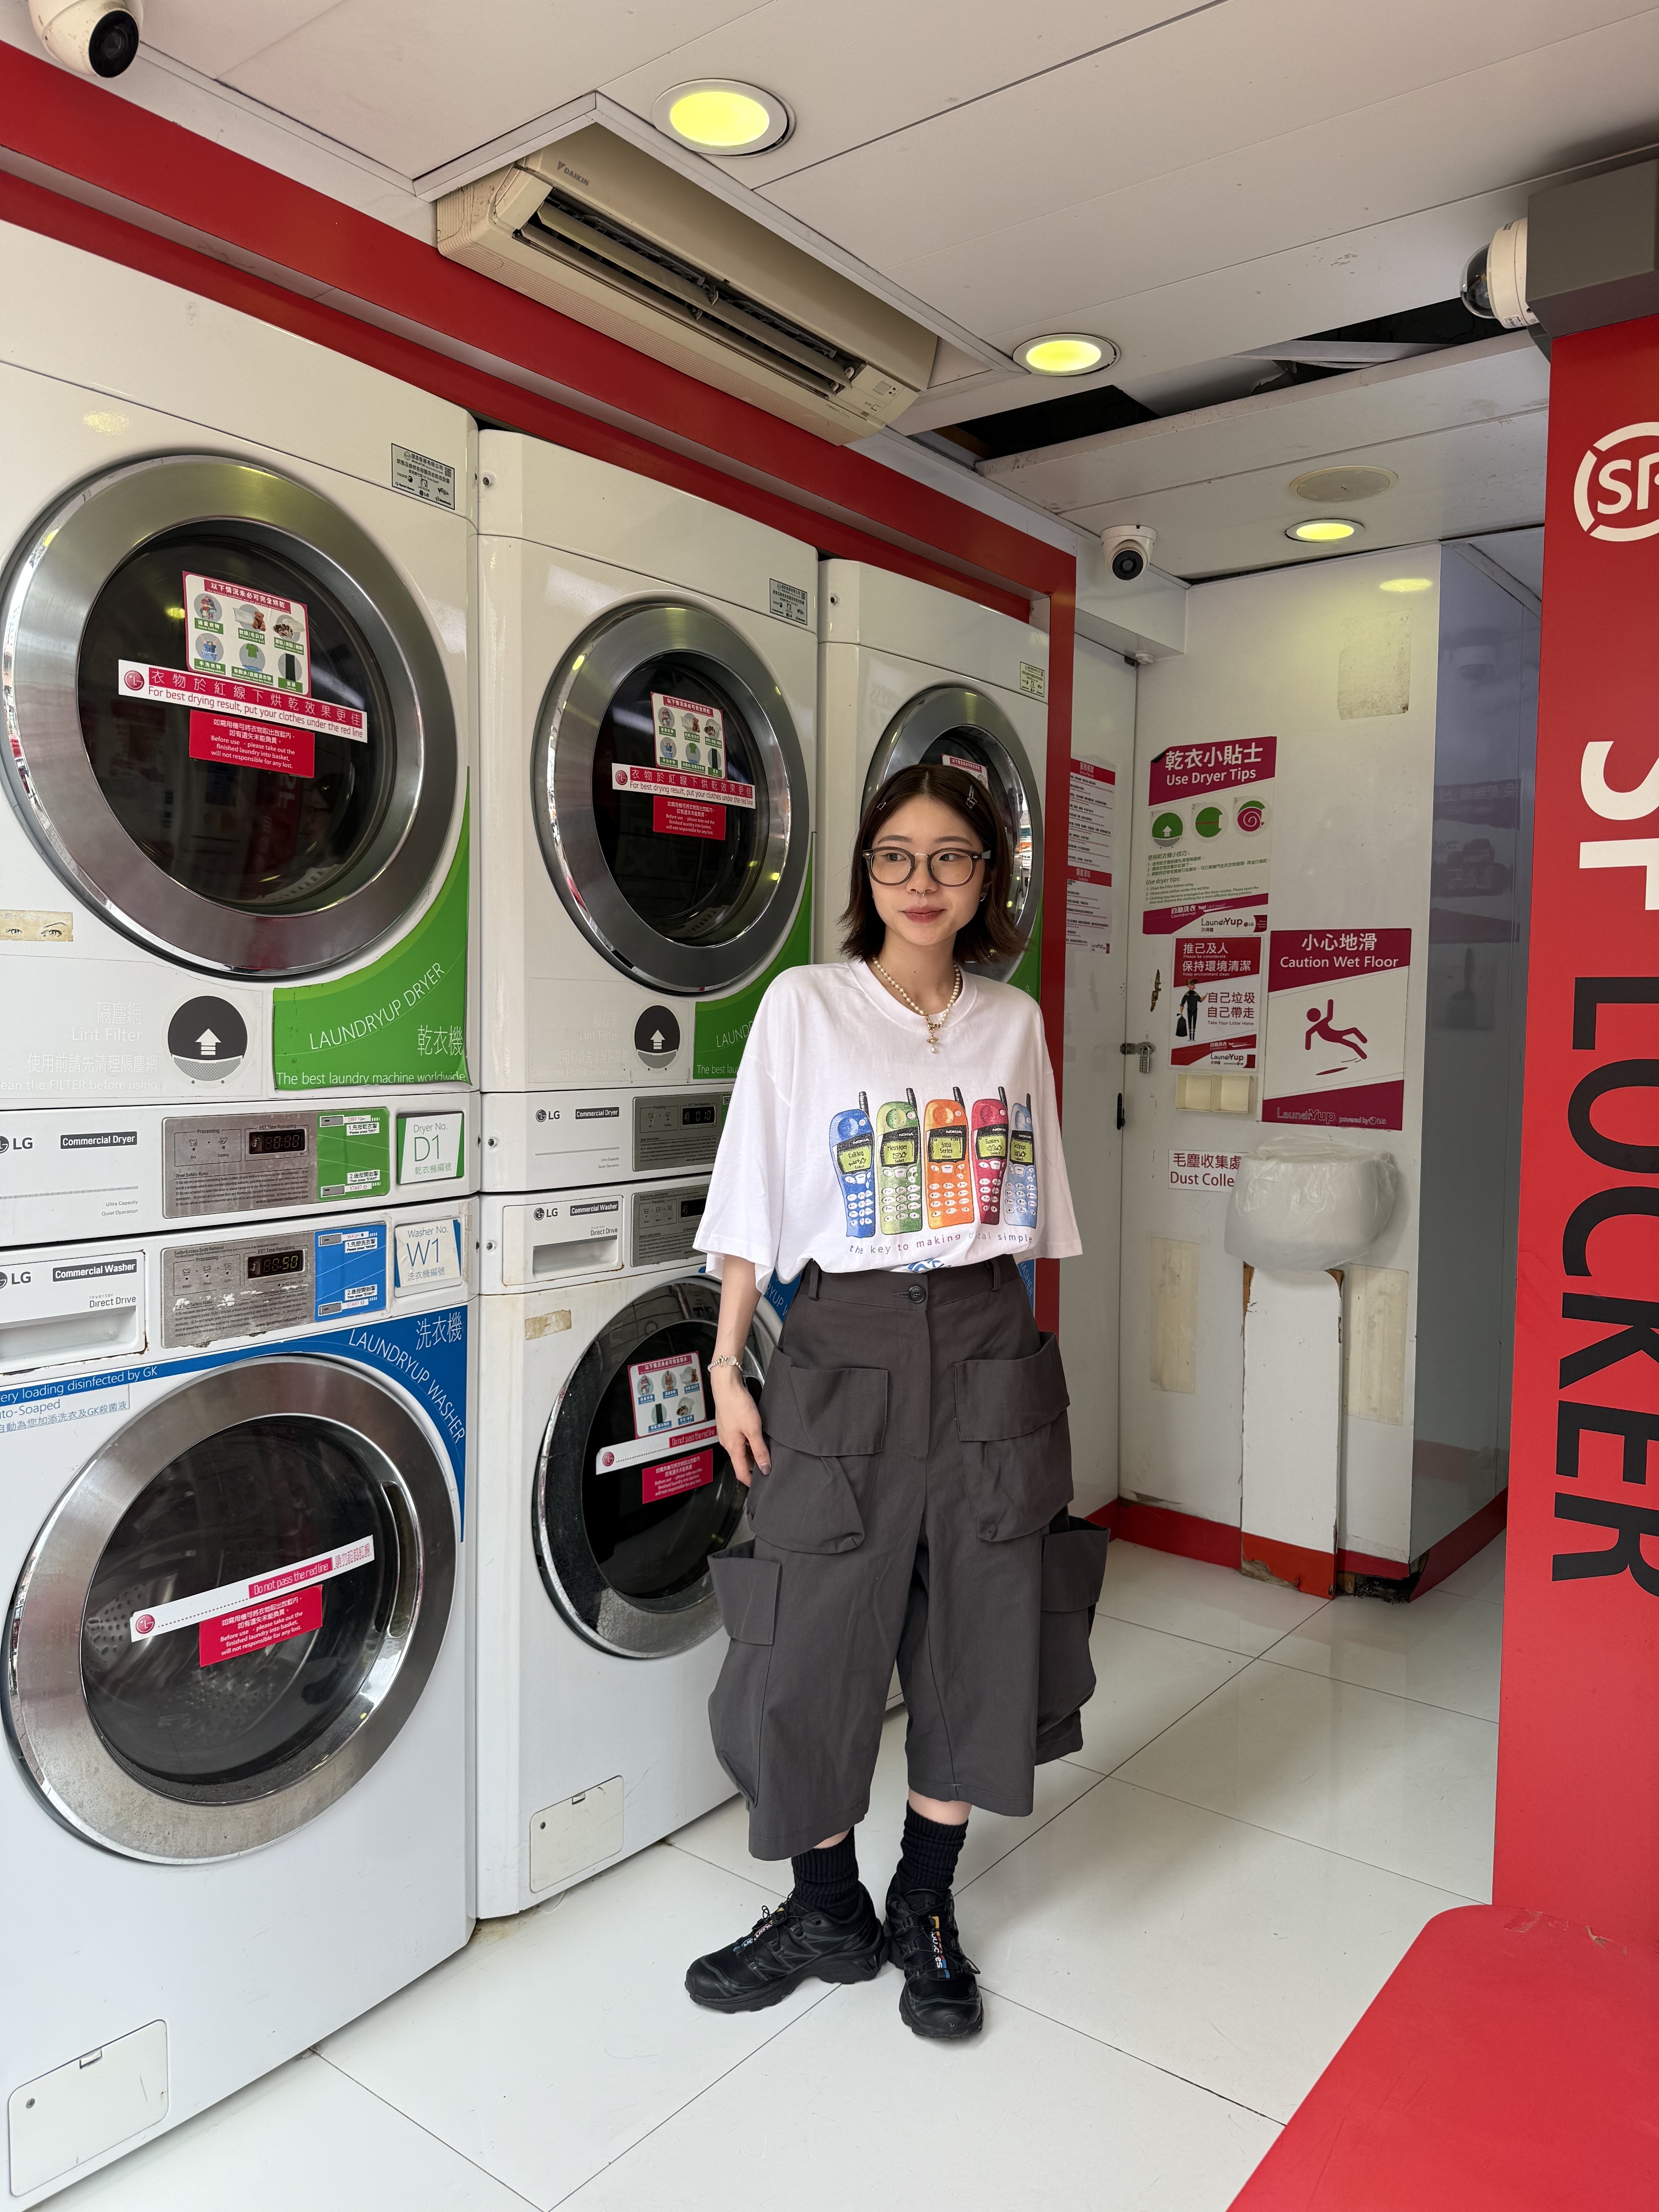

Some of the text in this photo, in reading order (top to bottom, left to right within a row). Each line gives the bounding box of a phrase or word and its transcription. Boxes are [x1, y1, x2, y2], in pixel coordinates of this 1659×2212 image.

[564, 167, 589, 186] DAIKIN
[211, 582, 286, 609] 以下情況未必可完全烘乾
[151, 670, 361, 726] 衣物於紅線下烘乾效果更佳
[149, 686, 363, 738] For best drying result, put your clothes under the red line
[211, 735, 229, 744] Before
[216, 744, 238, 752] finished
[240, 747, 260, 756] laundry
[272, 752, 290, 761] basket,
[233, 754, 263, 764] responsible
[1165, 742, 1263, 771] 乾衣小貼士
[631, 769, 753, 797] 衣物於紅線下烘乾效果更佳
[1166, 768, 1256, 786] Use Dryer Tips
[1201, 917, 1243, 927] LaundrYup
[1183, 942, 1228, 954] 推己及人
[1301, 933, 1377, 951] 小心地滑
[1183, 960, 1251, 972] 保持環境清潔
[1280, 956, 1399, 967] Caution Wet Floor
[1208, 992, 1255, 1004] 自己垃圾
[97, 1001, 142, 1025] 隔塵網
[310, 963, 445, 1050] LAUNDRYUP DRYER
[1207, 1006, 1254, 1018] 自己帶走
[72, 1028, 143, 1042] Lint Filter
[417, 1025, 463, 1056] 乾衣機
[579, 1030, 620, 1041] Lint Filter
[27, 1053, 158, 1074] 使用前請先清理隔塵網
[1211, 1052, 1244, 1062] LaundrYup
[276, 1071, 466, 1085] The best laundry machine worldwide
[612, 1069, 629, 1078] using
[27, 1080, 158, 1093] the FILTER before using
[548, 1111, 560, 1120] LG
[1277, 1107, 1335, 1124] LaundrYup
[414, 1124, 433, 1135] Dryer
[13, 1137, 33, 1150] LG
[62, 1135, 135, 1147] Commercial Dryer
[414, 1135, 440, 1162] D1
[1173, 1153, 1242, 1170] 毛塵收集處
[415, 1163, 452, 1175] 乾衣機編號
[1170, 1171, 1235, 1187] Dust Colle
[546, 1208, 558, 1217] LG
[572, 1203, 618, 1215] Commercial Washer
[408, 1225, 448, 1238] Washer No.
[850, 1233, 1032, 1254] the key to making simple
[406, 1238, 440, 1267] W1
[55, 1262, 136, 1279] Commercial Washer
[407, 1267, 445, 1281] 洗衣機編號
[11, 1271, 32, 1285] LG
[89, 1295, 136, 1308] Direct Drive
[416, 1312, 462, 1350] 洗衣機
[22, 1365, 158, 1399] loading disinfected by GK
[349, 1328, 465, 1444] LAUNDRYUP WASHER
[254, 1562, 329, 1595] Do not pass the red line
